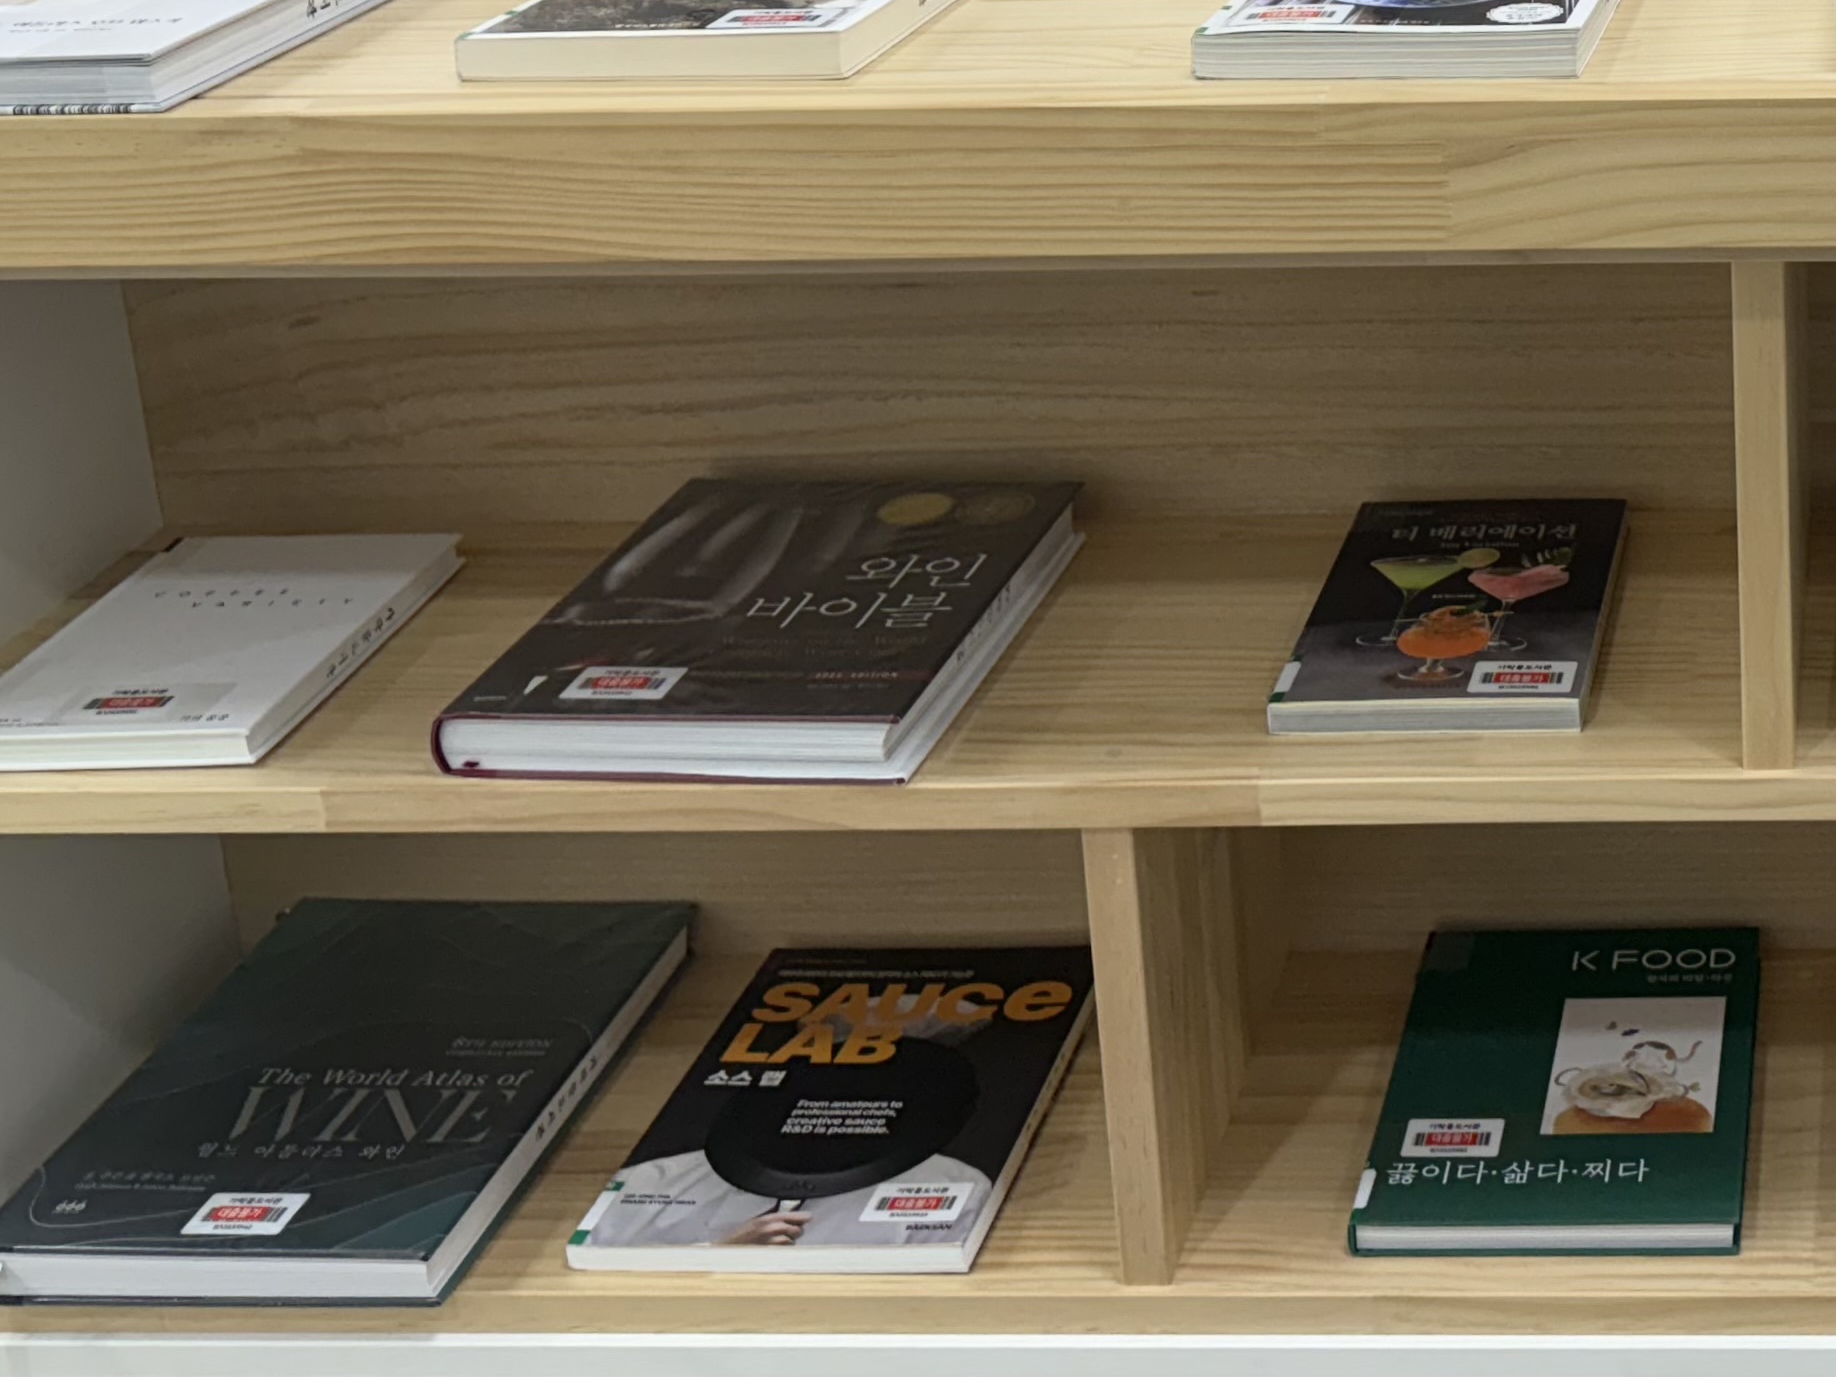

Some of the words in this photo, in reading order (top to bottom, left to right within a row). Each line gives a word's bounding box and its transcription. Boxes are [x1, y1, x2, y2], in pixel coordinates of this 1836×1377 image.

[1392, 527, 1416, 541] 더
[847, 554, 987, 589] 와인
[746, 592, 952, 629] 바이블
[1501, 674, 1544, 683] 대출불가
[1573, 951, 1597, 971] K
[1612, 949, 1736, 970] FOOD
[719, 1023, 902, 1064] LAB
[257, 1068, 311, 1085] The
[323, 1068, 406, 1085] World
[412, 1069, 488, 1086] Atlas
[497, 1069, 533, 1085] of
[704, 1071, 752, 1085] 소스
[758, 1070, 787, 1086] 랩
[797, 1100, 828, 1109] From
[830, 1100, 887, 1108] amateurs
[889, 1100, 902, 1108] to
[228, 1087, 516, 1142] WINE
[792, 1108, 860, 1117] professional
[862, 1108, 897, 1117] chefs,
[786, 1117, 841, 1126] creative
[845, 1117, 886, 1125] sauce
[781, 1125, 813, 1134] R&D
[815, 1125, 826, 1133] is
[827, 1125, 890, 1135] possible.
[1431, 1135, 1472, 1144] 대출불가
[358, 1144, 404, 1158] 와인
[1387, 1159, 1649, 1184] 끓이다·삶다·찌다
[893, 1198, 938, 1209] 대출불가
[218, 1207, 263, 1221] 대출불가
